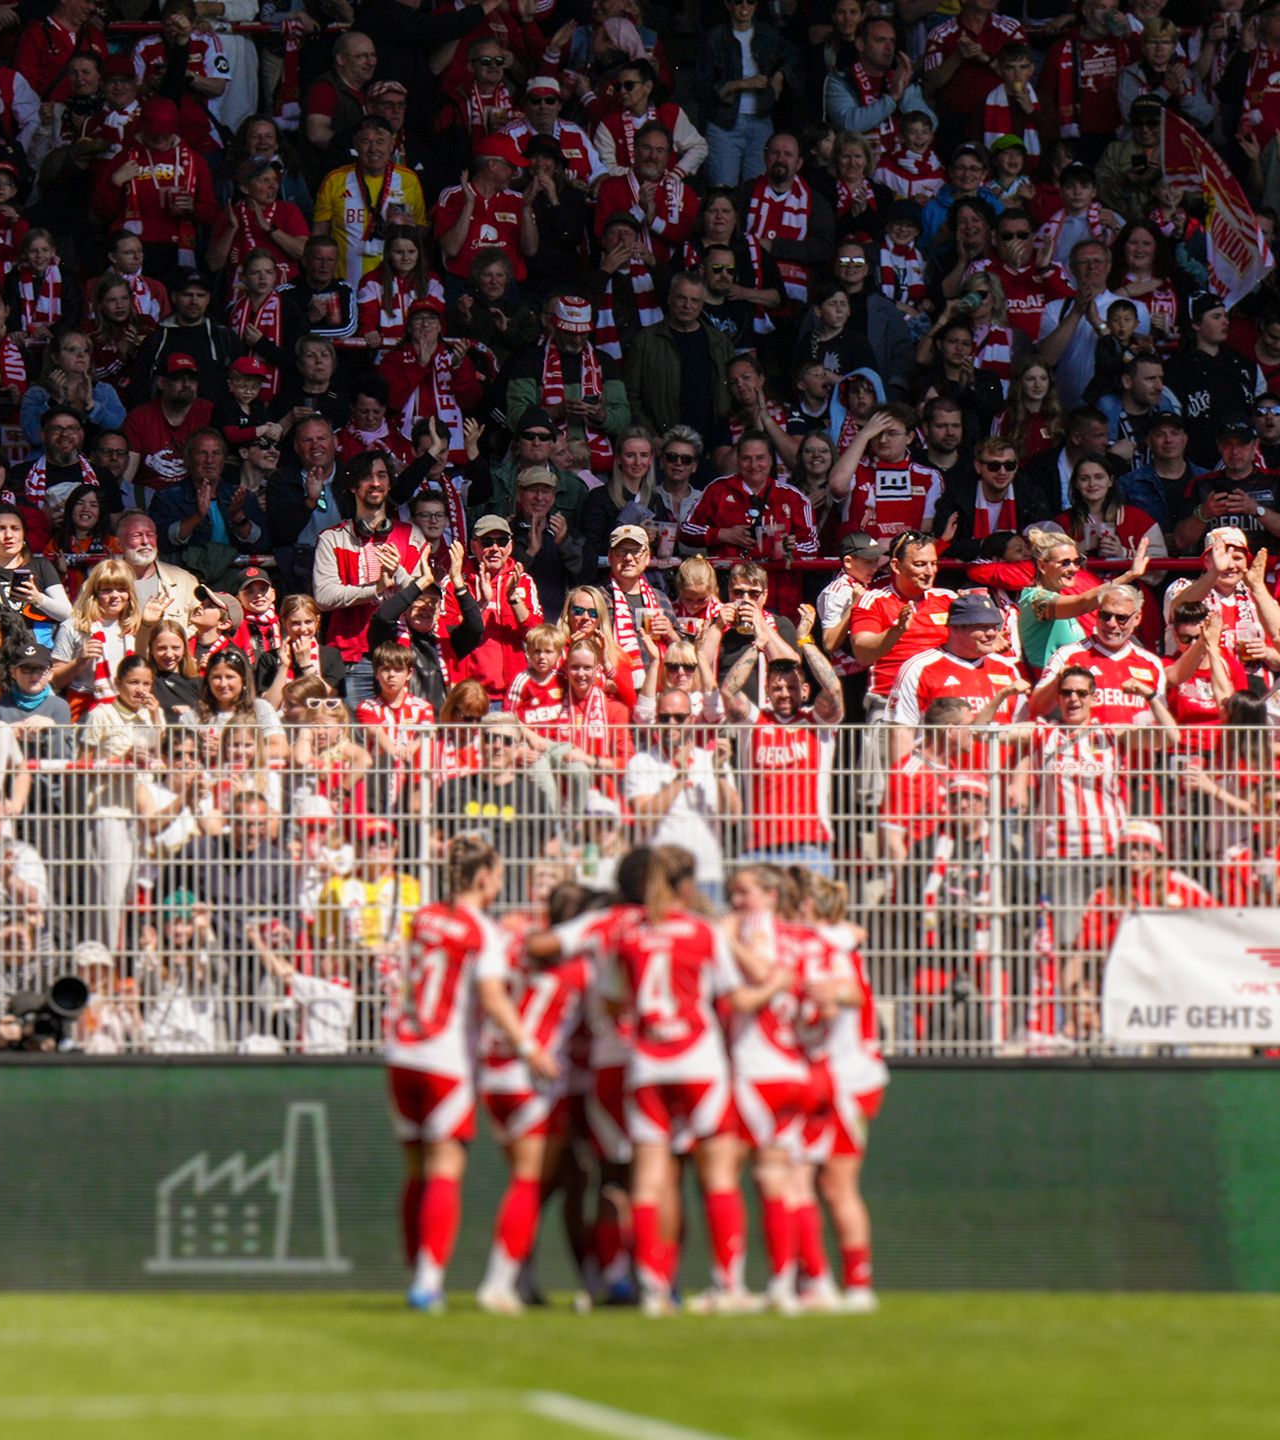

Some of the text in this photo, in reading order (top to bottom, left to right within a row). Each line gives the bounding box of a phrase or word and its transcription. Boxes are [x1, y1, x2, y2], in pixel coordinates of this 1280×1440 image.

[757, 742, 809, 765] BERLIN
[636, 948, 677, 1020] 4
[1128, 1005, 1177, 1030] AUF
[1186, 1005, 1272, 1030] GEHTS
